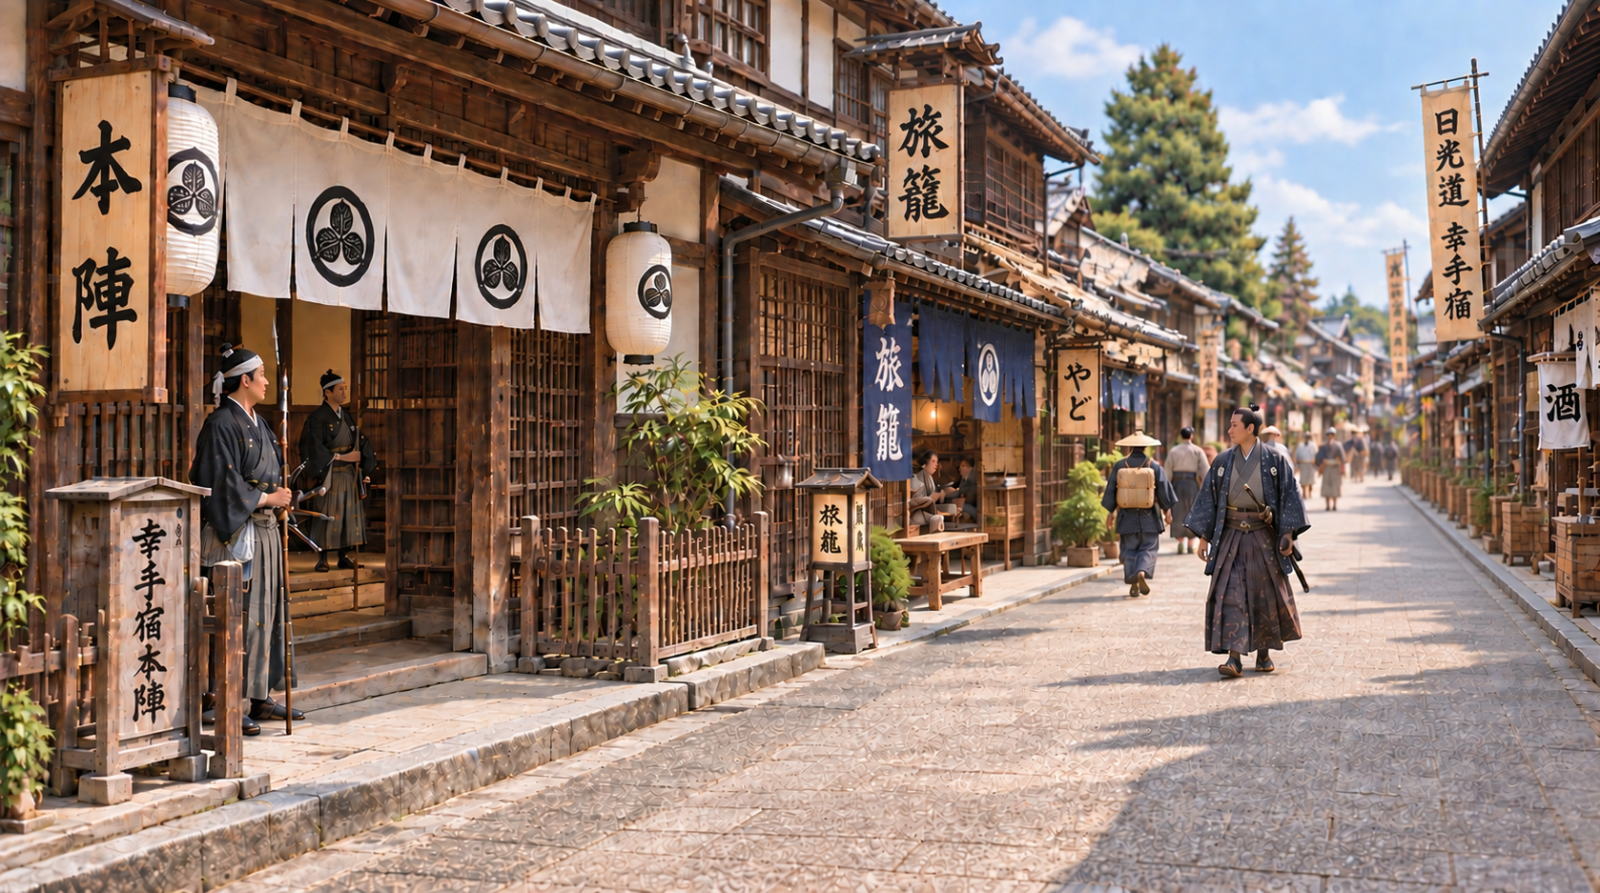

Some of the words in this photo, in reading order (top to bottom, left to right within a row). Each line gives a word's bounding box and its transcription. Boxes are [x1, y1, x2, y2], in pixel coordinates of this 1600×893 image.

[898, 104, 950, 223] 旅籠
[1434, 108, 1470, 208] 日光道
[71, 119, 143, 351] 本陣
[874, 336, 904, 461] 旅籠
[1063, 361, 1092, 421] やど
[1544, 382, 1582, 423] 酒
[132, 518, 168, 725] 幸手宿本陣
